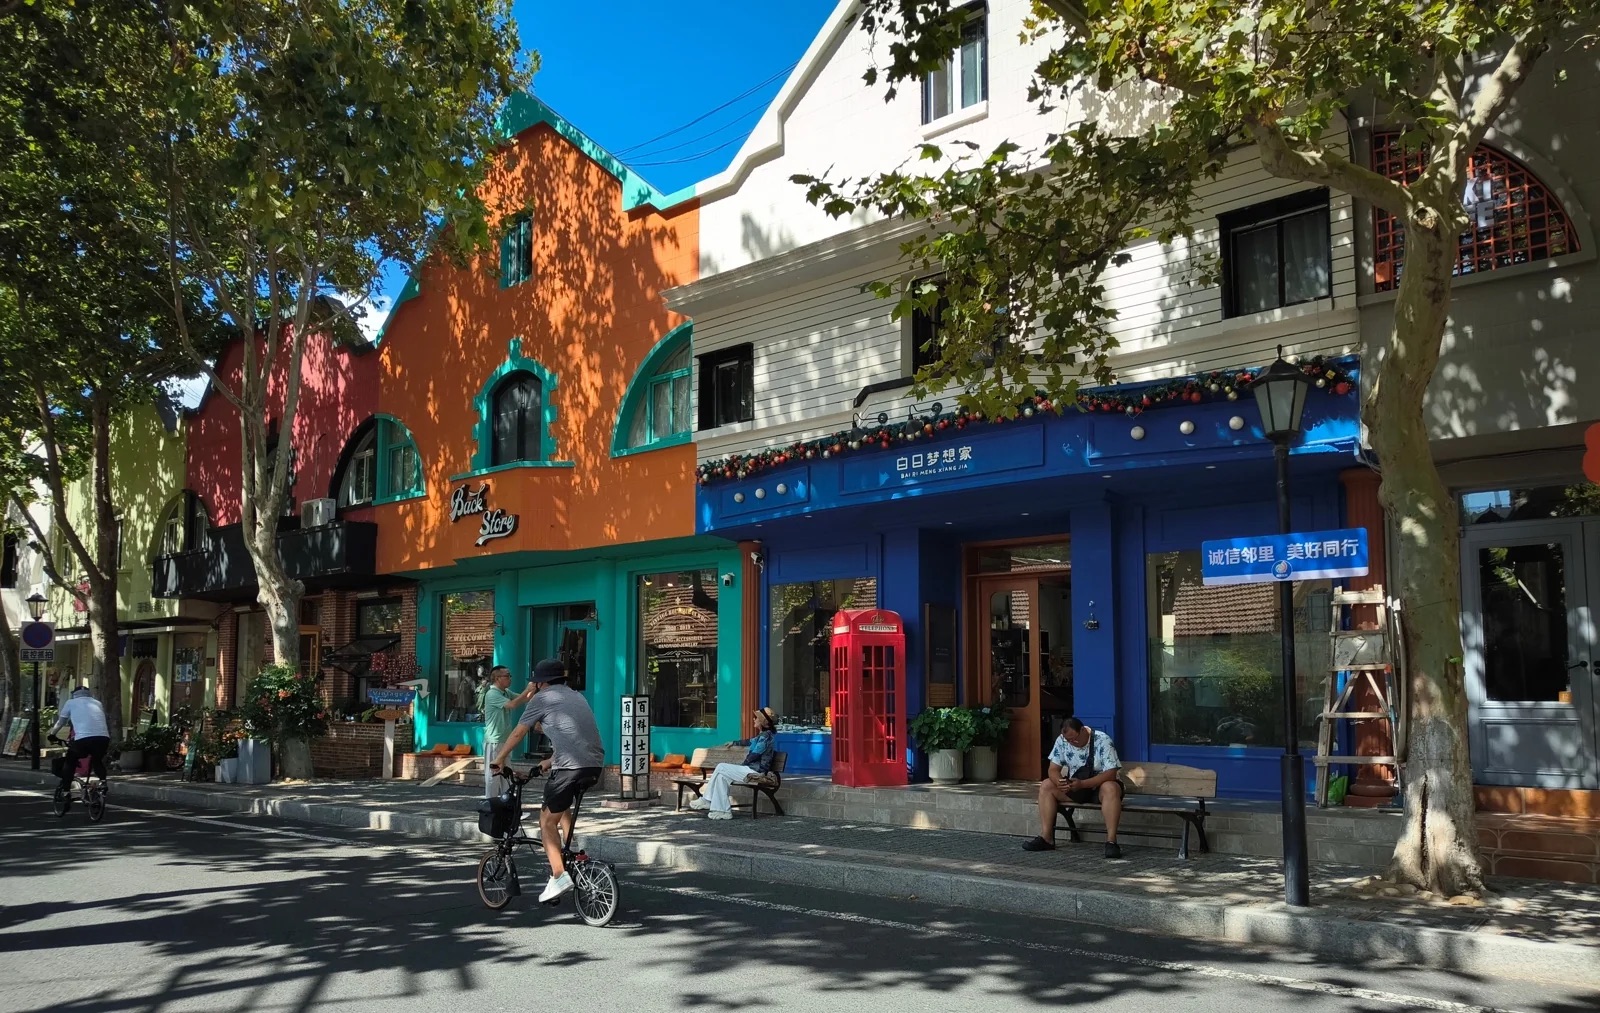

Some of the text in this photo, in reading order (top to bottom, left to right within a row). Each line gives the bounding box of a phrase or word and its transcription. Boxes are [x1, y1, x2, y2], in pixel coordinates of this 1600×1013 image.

[896, 446, 972, 471] 白日梦想家
[920, 468, 937, 476] MENG
[938, 464, 957, 473] XIANG
[449, 484, 517, 544] Back Store
[1208, 539, 1359, 566] 诚信邻里 美好同行
[623, 700, 632, 772] 百科士多
[637, 700, 647, 772] 百科士多
